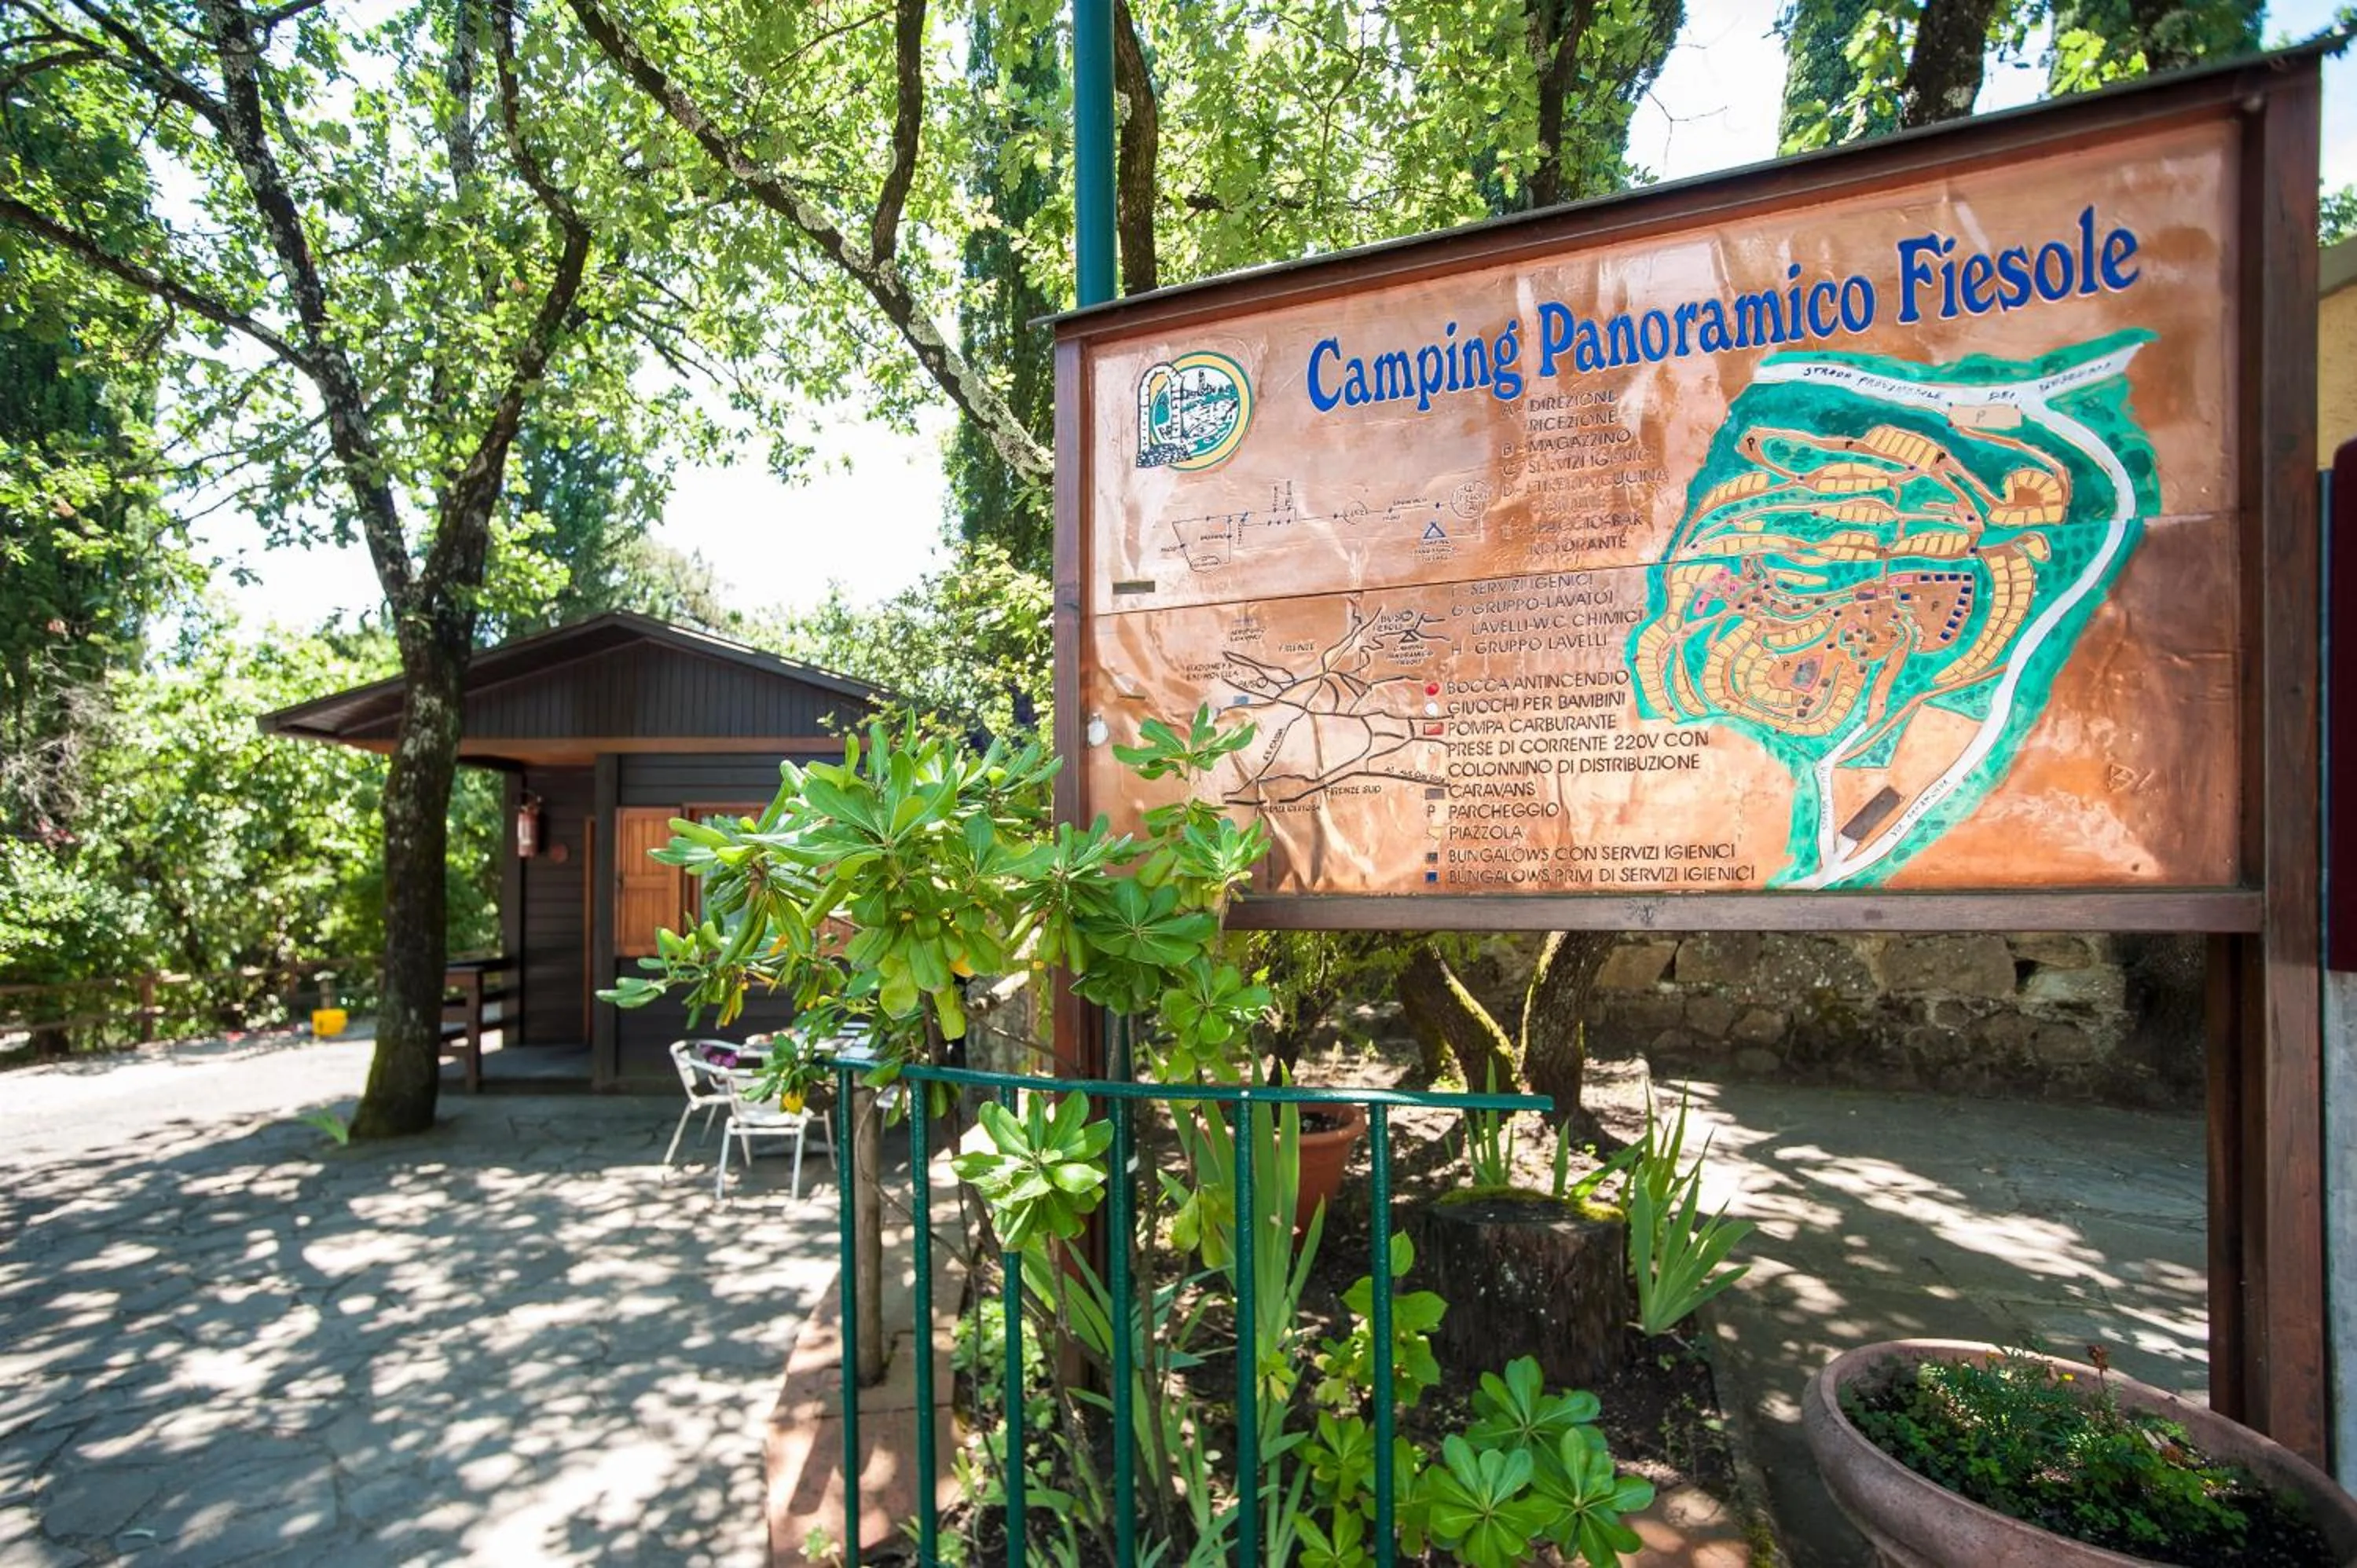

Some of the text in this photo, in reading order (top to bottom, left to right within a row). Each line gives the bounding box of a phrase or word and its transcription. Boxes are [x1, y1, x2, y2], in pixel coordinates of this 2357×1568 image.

[1307, 207, 2141, 412] Camping Panoramico Fiesole
[1529, 390, 1615, 413] DIREZIONE
[1529, 409, 1616, 432] RICEZIONE
[1528, 429, 1631, 453] MAGAZZINO
[1747, 438, 1755, 452] P
[1471, 579, 1524, 596] SERVIZI
[1572, 610, 1644, 628] CHIMICI
[1475, 637, 1542, 654] GRUPPO
[1549, 632, 1607, 650] LAVELLI
[1447, 671, 1630, 695] BOCCA ANTINCENDIO
[1447, 691, 1626, 716] GIUOCHI PER BAMBINI
[1447, 714, 1616, 737] POMPA CARBURANTE
[1447, 731, 1709, 758] PRESE DI CORRENTE 220V CON
[1448, 754, 1700, 779] COLONNINO DI DISTRIBUZIONE
[1448, 782, 1535, 799] CARAVANS
[1428, 802, 1559, 819] P PARCHEGGIO
[1450, 825, 1523, 841] PIAZZOLA
[1449, 843, 1735, 863] BUNGALOWS CON SERVIZI IGIENICI
[1449, 868, 1549, 884] BUNGALOWS
[1600, 868, 1615, 881] DI
[1619, 866, 1677, 882] SERVIZI
[1684, 865, 1754, 881] IGIENICI
